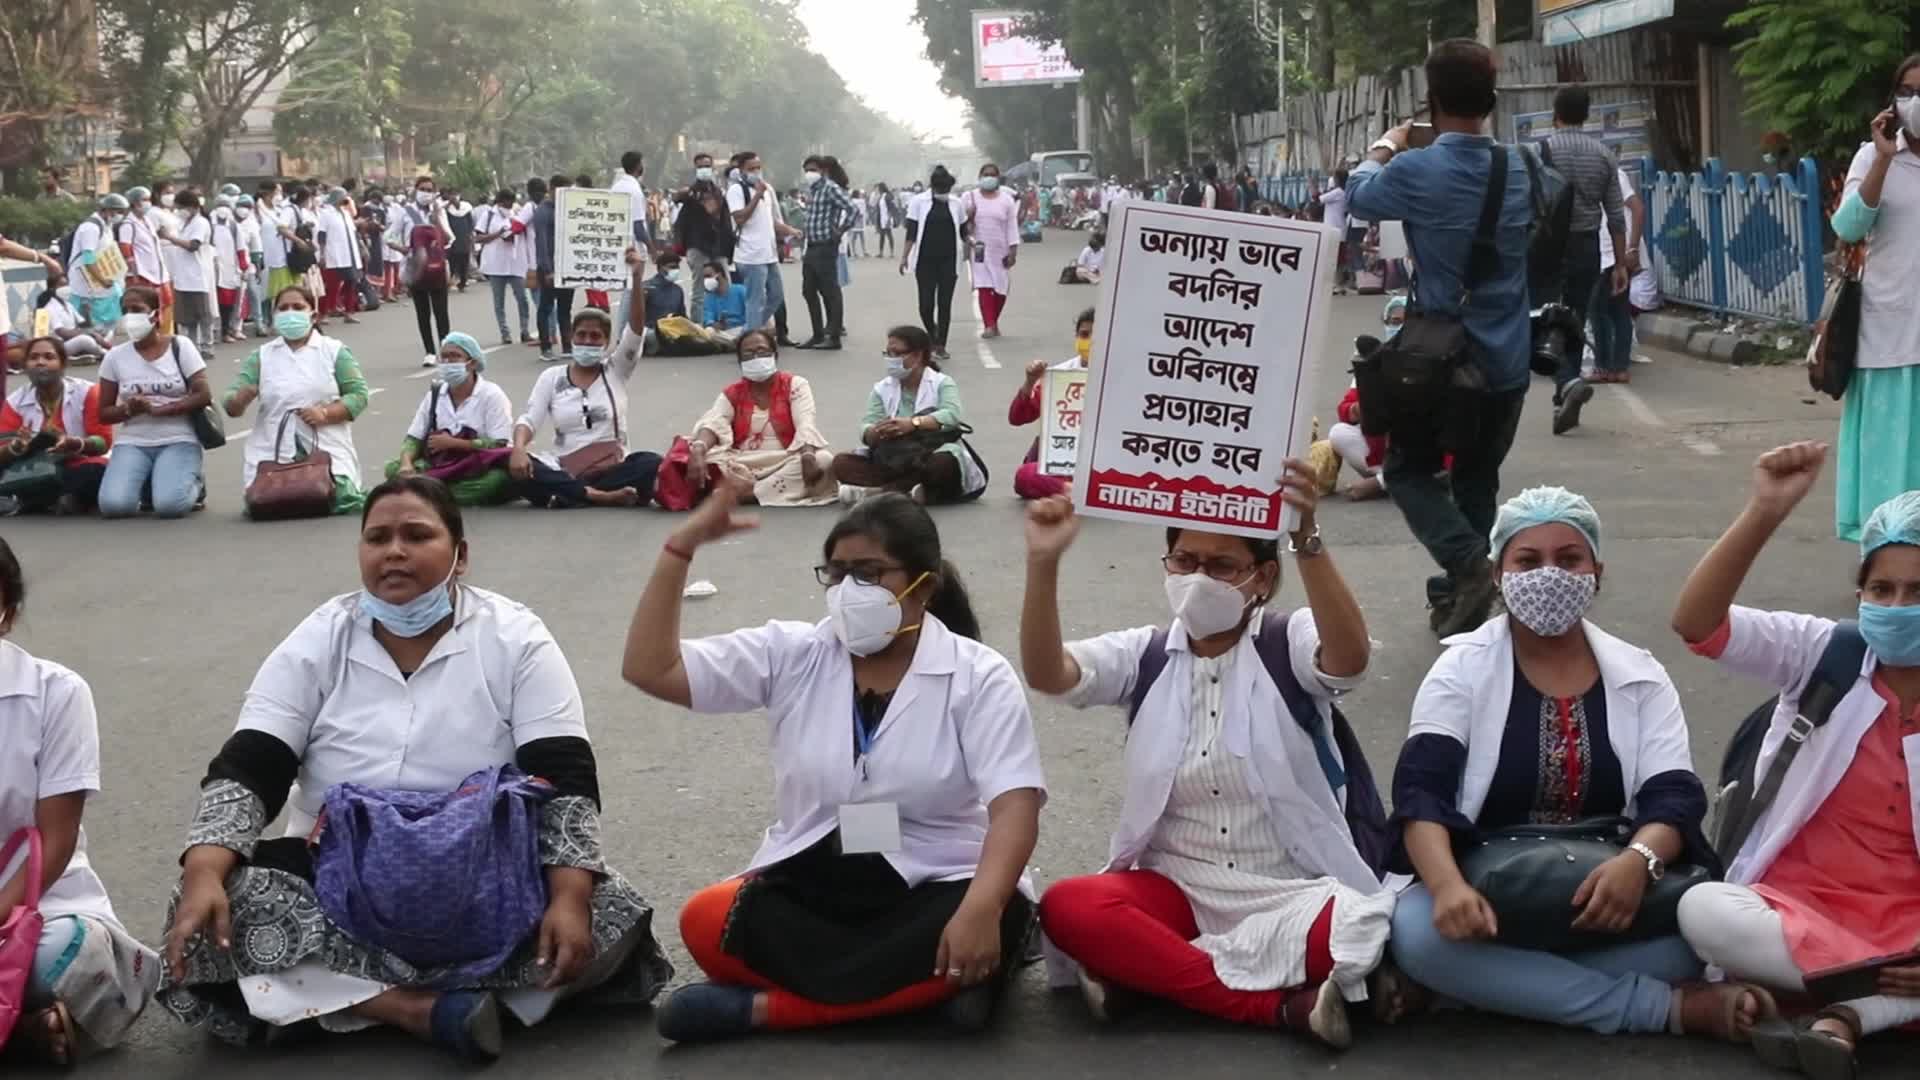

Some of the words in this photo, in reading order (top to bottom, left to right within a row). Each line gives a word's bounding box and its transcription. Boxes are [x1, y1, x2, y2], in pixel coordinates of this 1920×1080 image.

[1140, 227, 1229, 265] অন্যায়
[1239, 239, 1302, 274] ভাবে
[1168, 269, 1262, 310] বদলির
[1164, 313, 1254, 347] আদেশ
[1148, 347, 1259, 395] অবিলম্বে
[1142, 393, 1252, 433] প্রত্যাহার
[1121, 430, 1203, 467] করতে
[1211, 442, 1262, 474] হবে
[1098, 481, 1176, 512] নার্সেস
[1180, 489, 1270, 524] ইউনিটি
